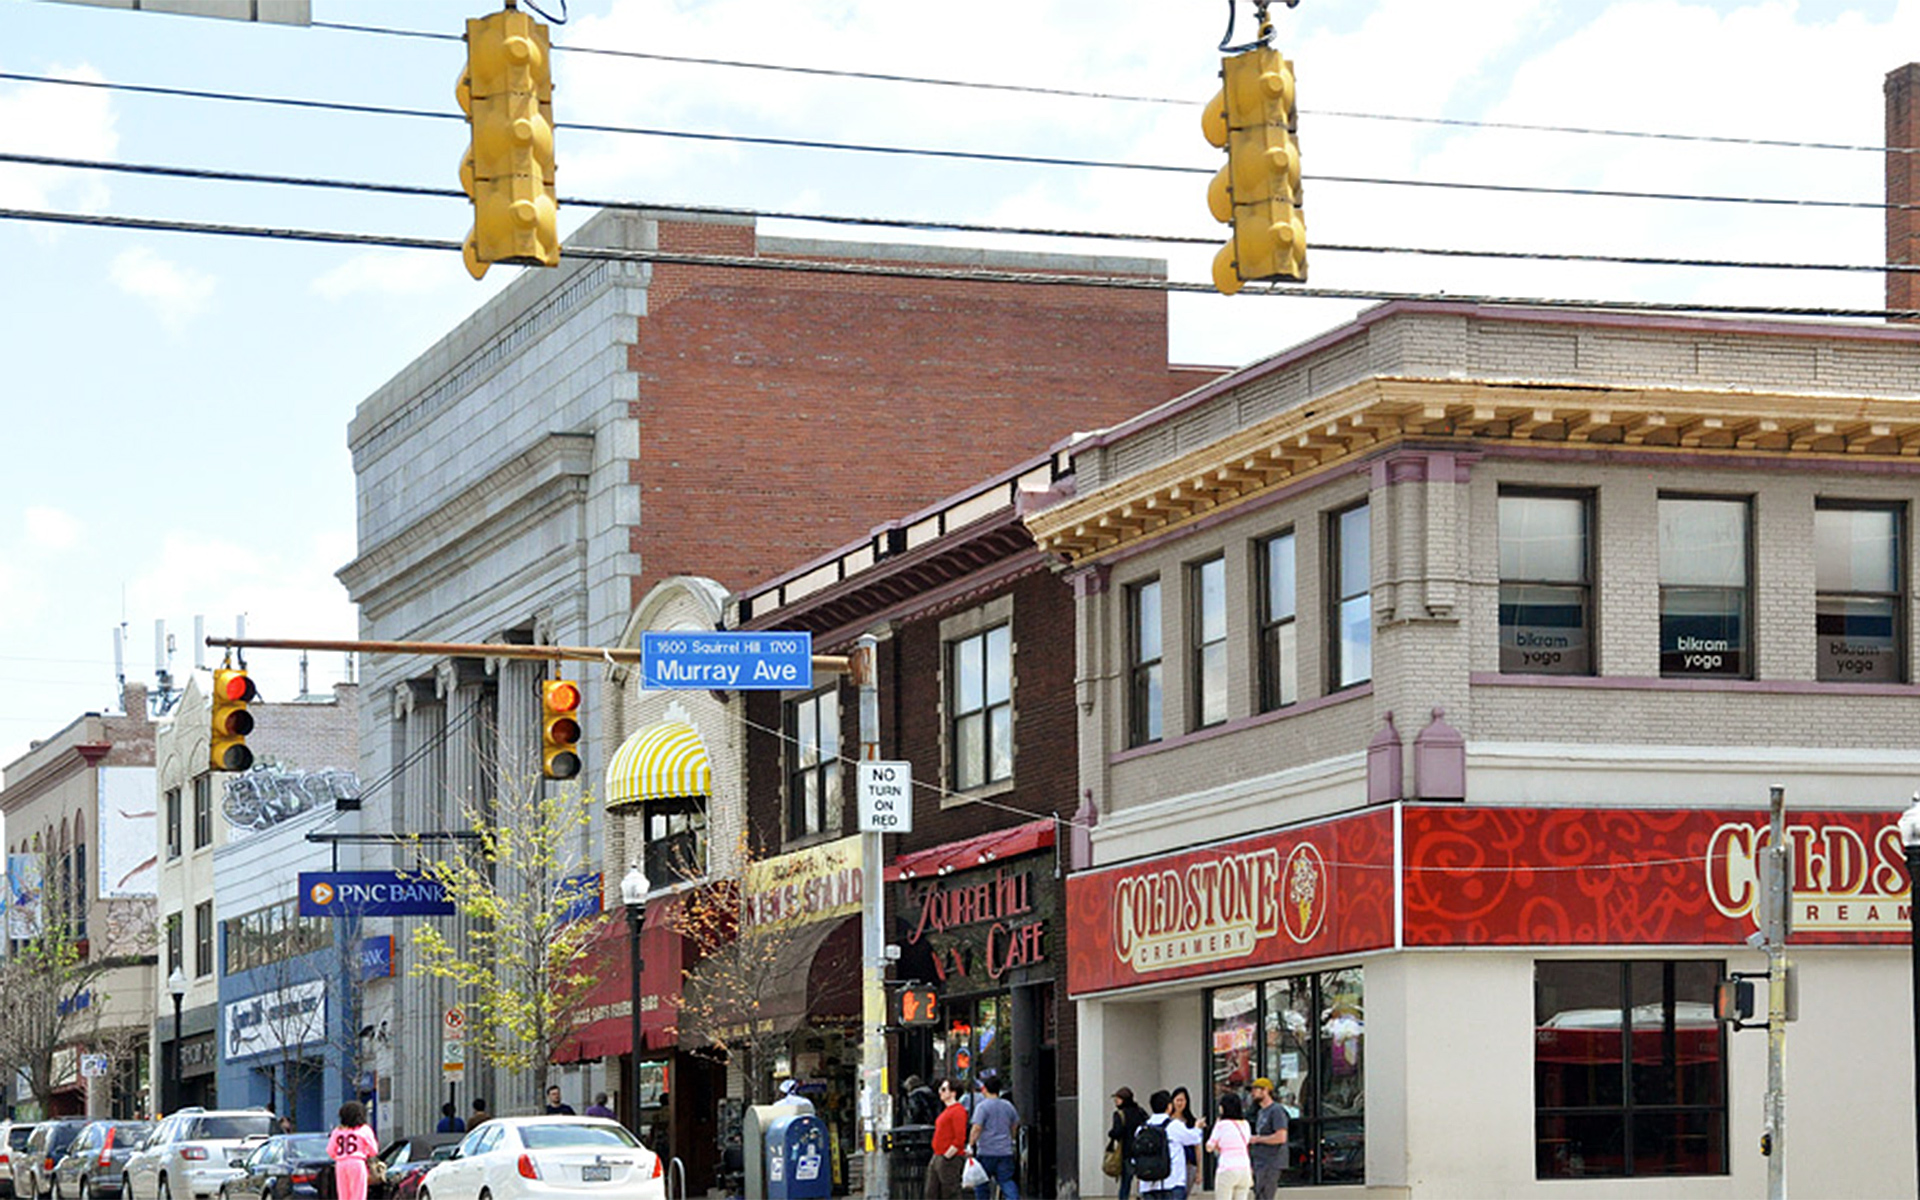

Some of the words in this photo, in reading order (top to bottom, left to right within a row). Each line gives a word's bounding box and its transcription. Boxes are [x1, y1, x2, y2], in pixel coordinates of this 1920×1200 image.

[656, 640, 687, 654] 1600
[692, 640, 740, 654] Squirrel
[744, 640, 761, 653] Hill
[769, 640, 797, 654] 1700
[1516, 632, 1569, 648] bikram
[1677, 636, 1728, 652] bikram
[1829, 642, 1881, 656] bikram
[1522, 651, 1562, 666] yoga
[1683, 654, 1723, 670] yoga
[656, 660, 741, 685] Murray
[753, 660, 798, 681] Ave
[1836, 660, 1874, 674] yoga
[872, 768, 896, 782] NO
[869, 785, 902, 797] TURN
[874, 800, 894, 811] ON
[872, 814, 898, 826] RED
[338, 884, 387, 902] PNC
[390, 884, 447, 902] BANK
[803, 867, 863, 915] STAND
[1115, 870, 1184, 962] COLD
[1184, 849, 1278, 940] STONE
[1140, 932, 1246, 962] CREAMERY
[926, 992, 937, 1019] 2
